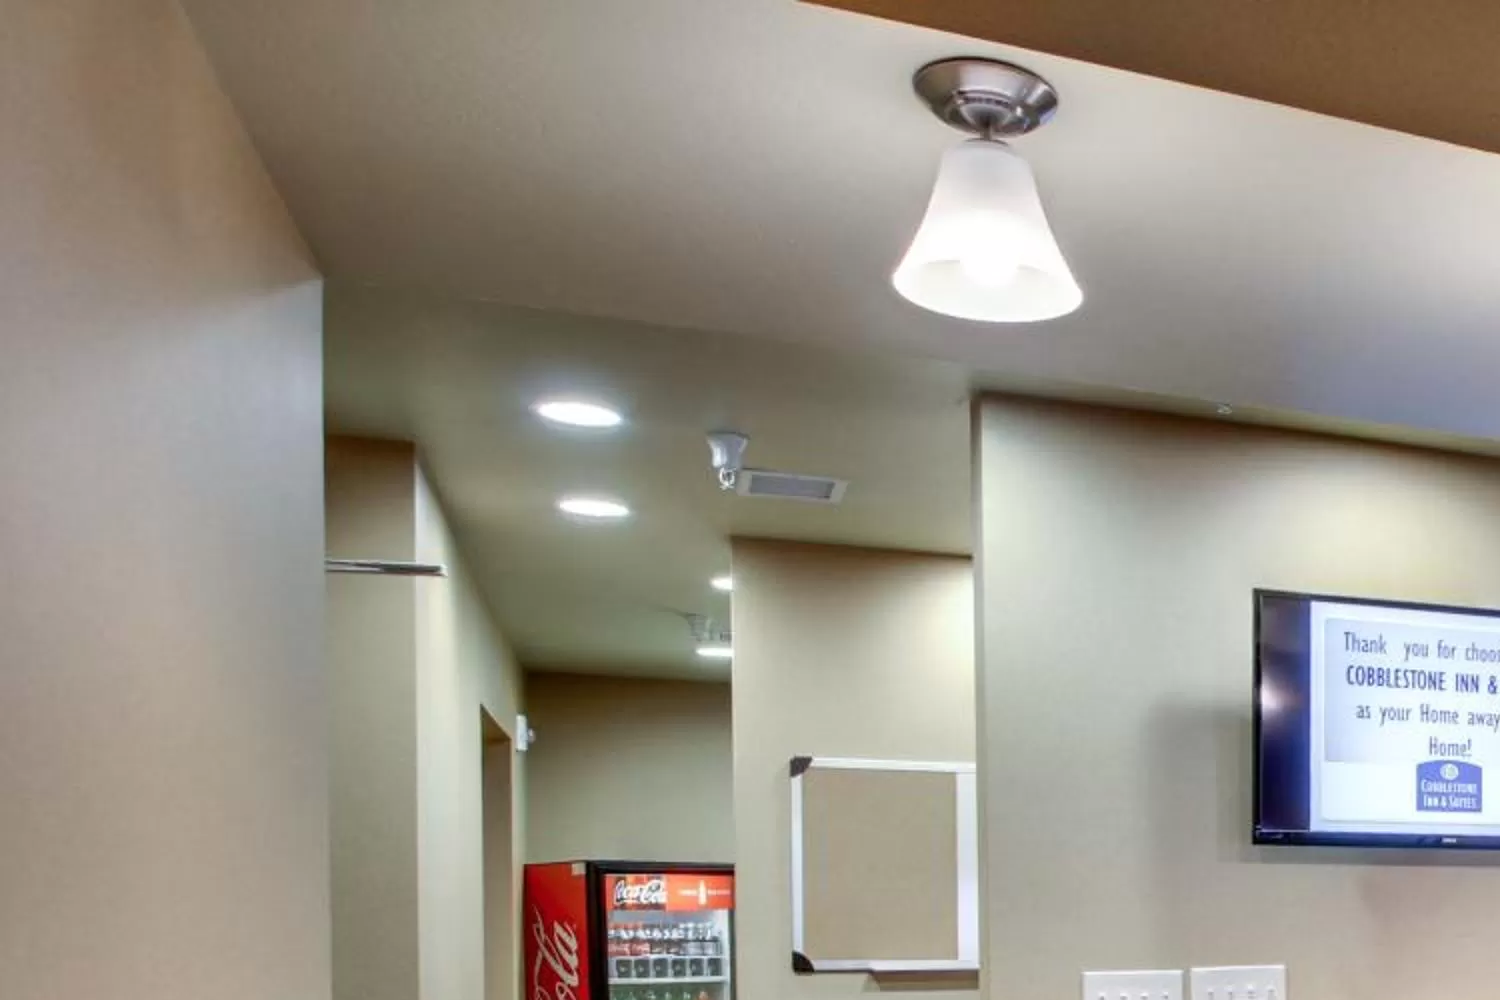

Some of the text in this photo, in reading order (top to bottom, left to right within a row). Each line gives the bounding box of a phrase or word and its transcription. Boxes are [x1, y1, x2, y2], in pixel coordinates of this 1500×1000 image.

[1344, 632, 1387, 654] Thank
[1404, 642, 1429, 661] you
[1437, 640, 1456, 660] for
[1346, 665, 1446, 691] COBBLESTONE
[1455, 673, 1480, 693] INN
[1488, 676, 1498, 694] &
[1356, 704, 1371, 719] as
[1379, 706, 1412, 726] your
[1420, 704, 1459, 725] Home
[1468, 710, 1500, 733] away
[1429, 736, 1473, 757] Home!
